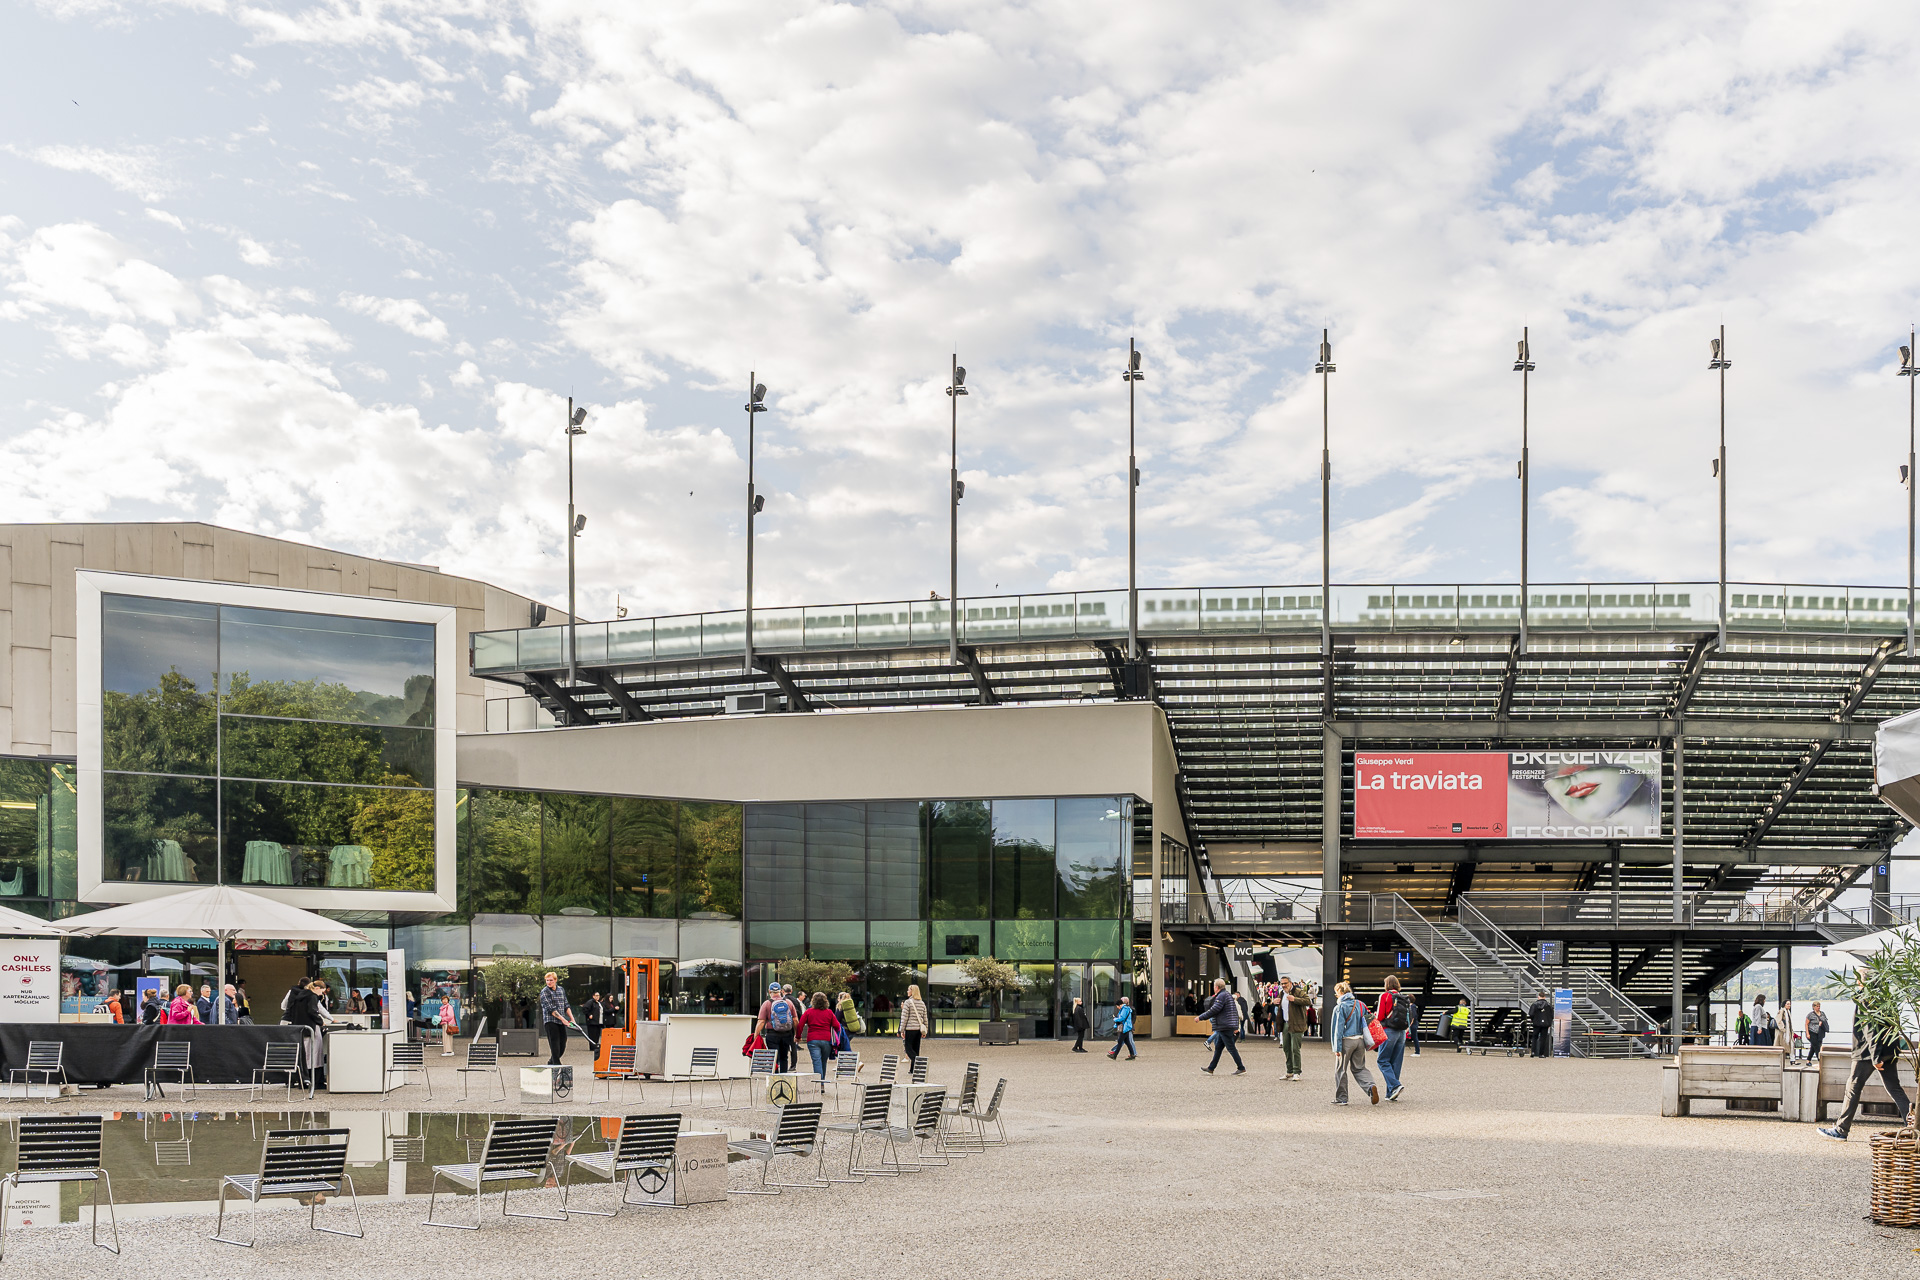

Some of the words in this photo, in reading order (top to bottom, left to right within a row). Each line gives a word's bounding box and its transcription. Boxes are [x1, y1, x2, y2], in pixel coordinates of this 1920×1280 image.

[1357, 758, 1393, 766] Giuseppe
[1394, 757, 1414, 765] Verdi
[1512, 752, 1660, 765] BREGENZER
[1357, 770, 1385, 790] La
[1390, 770, 1483, 790] traviata
[1879, 865, 1886, 875] G
[1235, 947, 1252, 956] WC
[1542, 943, 1555, 961] F
[1398, 952, 1410, 968] H
[1, 964, 52, 972] CASHLESS
[678, 1158, 699, 1175] 40
